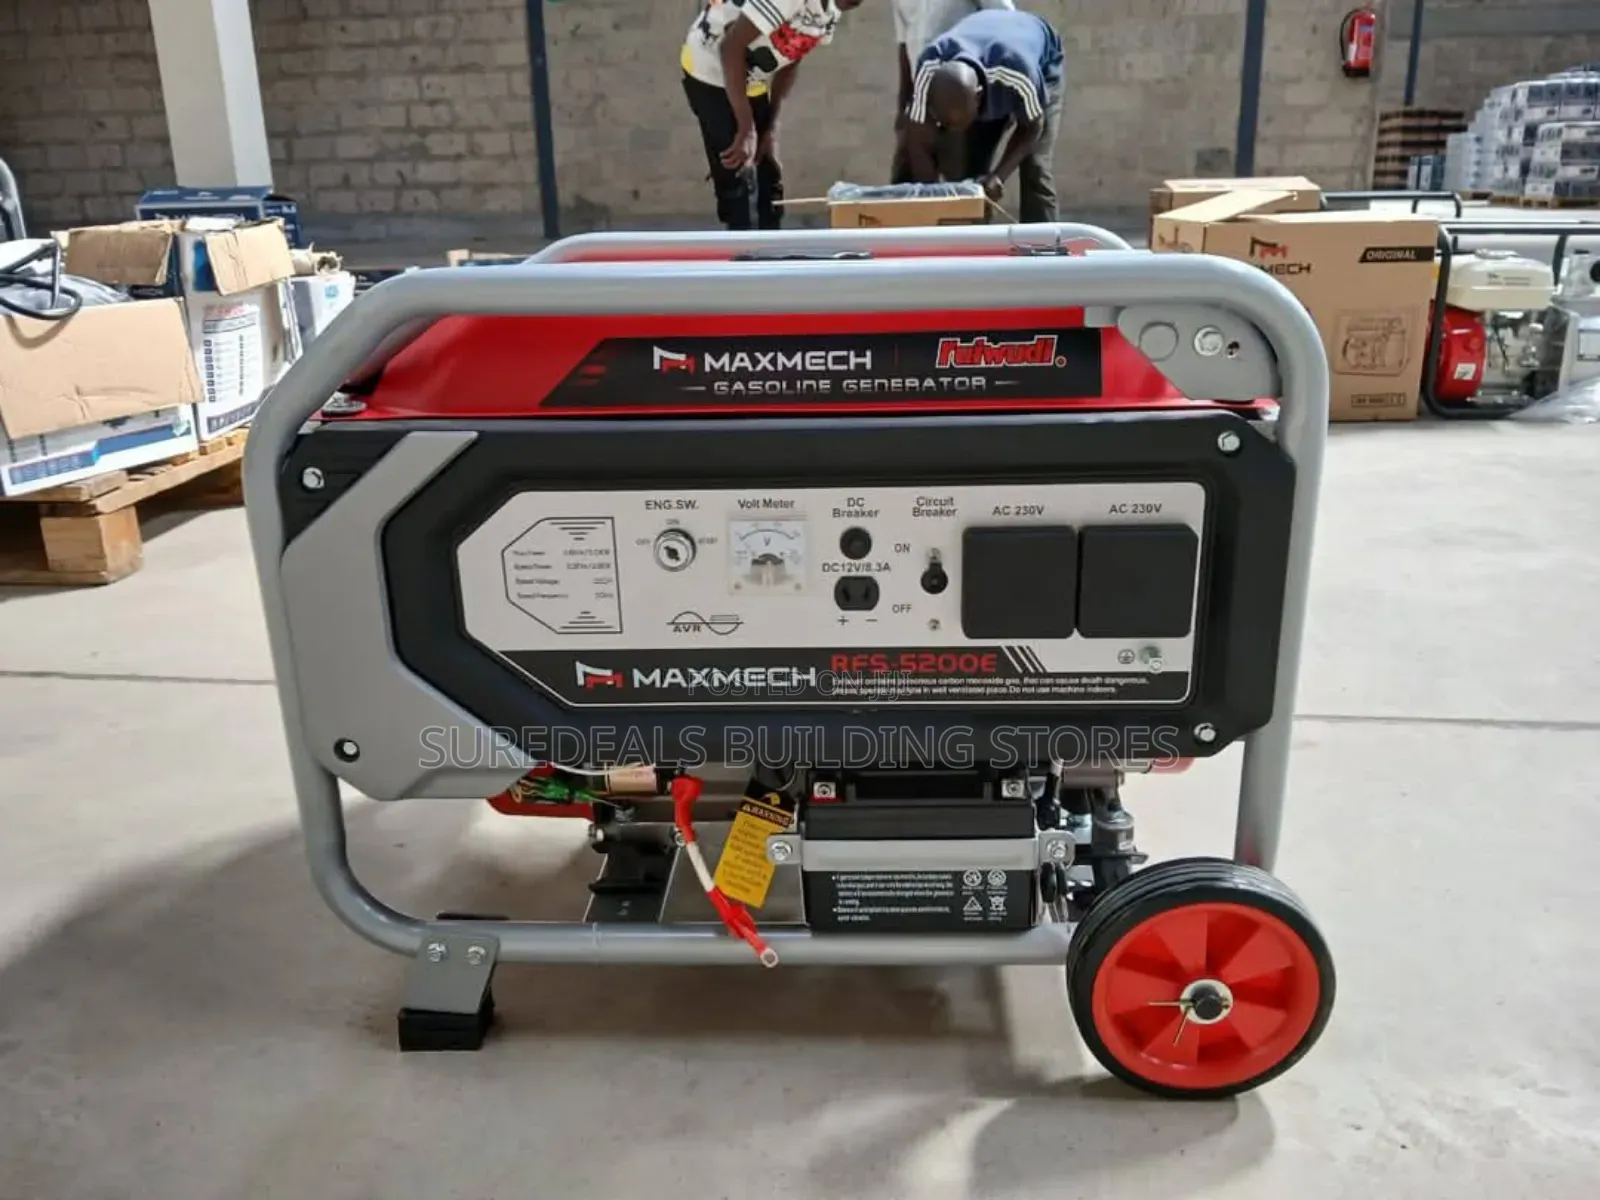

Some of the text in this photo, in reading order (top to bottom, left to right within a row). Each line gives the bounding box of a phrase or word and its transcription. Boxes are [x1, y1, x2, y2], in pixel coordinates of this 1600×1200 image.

[1365, 250, 1418, 261] ORIGINAL
[1255, 263, 1312, 275] MECH
[703, 350, 873, 372] MAXMECH
[713, 376, 987, 396] GASOLINE GENERATOR
[645, 499, 700, 511] ENG.SW.
[737, 498, 795, 509] Volt Meter
[847, 497, 865, 508] DC
[916, 496, 954, 507] Circuit
[832, 508, 880, 518] Breaker
[912, 507, 958, 518] Breaker
[992, 505, 1045, 516] AC 230V
[1109, 503, 1163, 514] AC 230V
[763, 535, 772, 547] V
[894, 543, 911, 553] ON
[821, 562, 892, 573] DC12V/8.3A
[892, 604, 913, 614] OFF
[672, 624, 703, 633] AVR
[830, 653, 998, 673] RFS-5200E
[632, 667, 817, 689] MAXMECH
